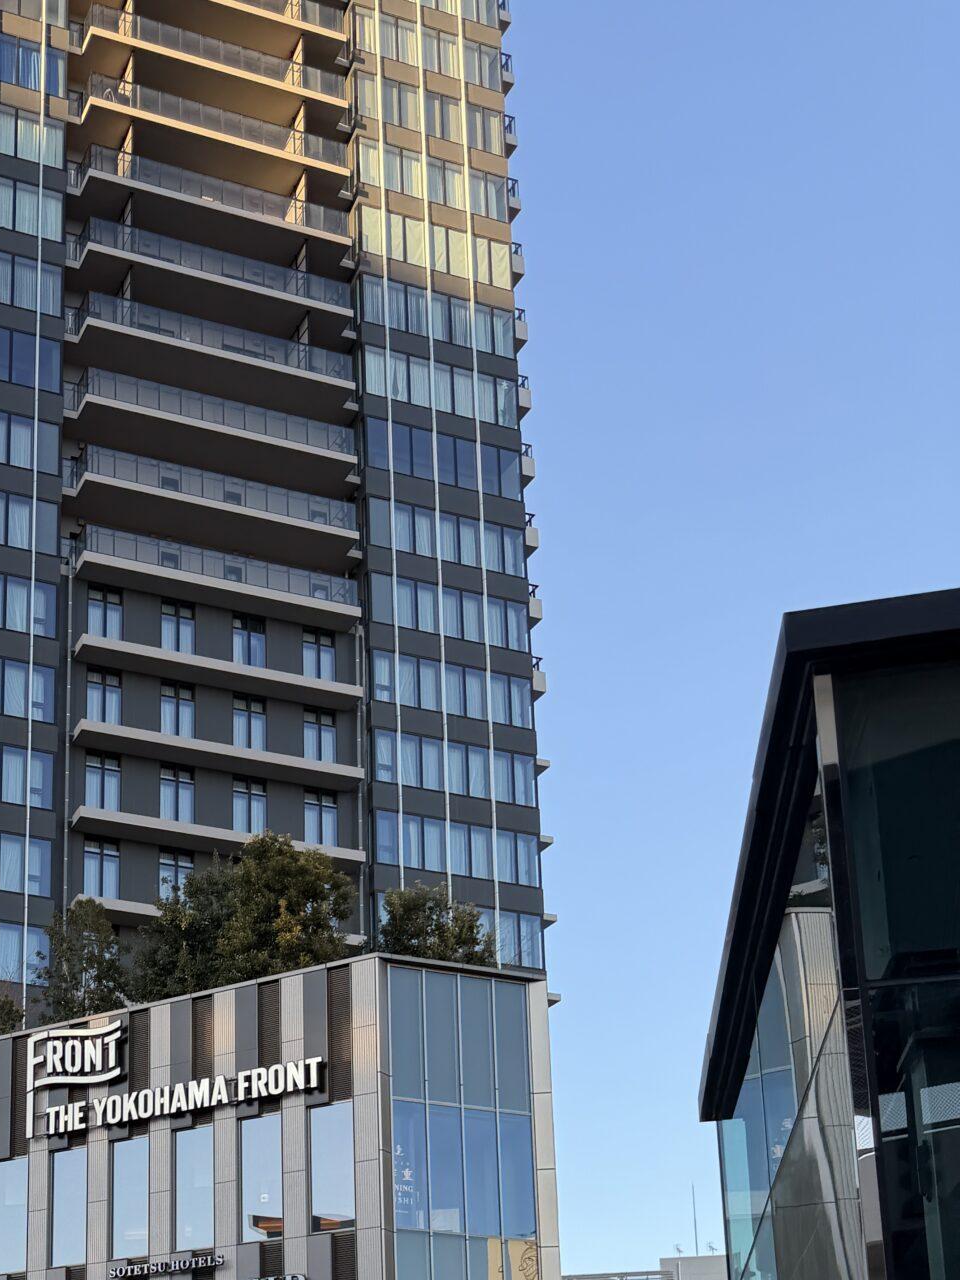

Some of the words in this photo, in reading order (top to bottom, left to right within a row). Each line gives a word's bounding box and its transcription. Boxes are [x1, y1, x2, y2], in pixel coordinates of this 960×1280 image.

[26, 1019, 122, 1138] FRONT
[46, 1100, 86, 1135] THE
[93, 1074, 229, 1126] YOKOHAMA
[238, 1056, 323, 1102] FRONT
[394, 1183, 414, 1192] NING
[109, 1259, 169, 1279] SOTETSU
[171, 1253, 224, 1272] HOTELS
